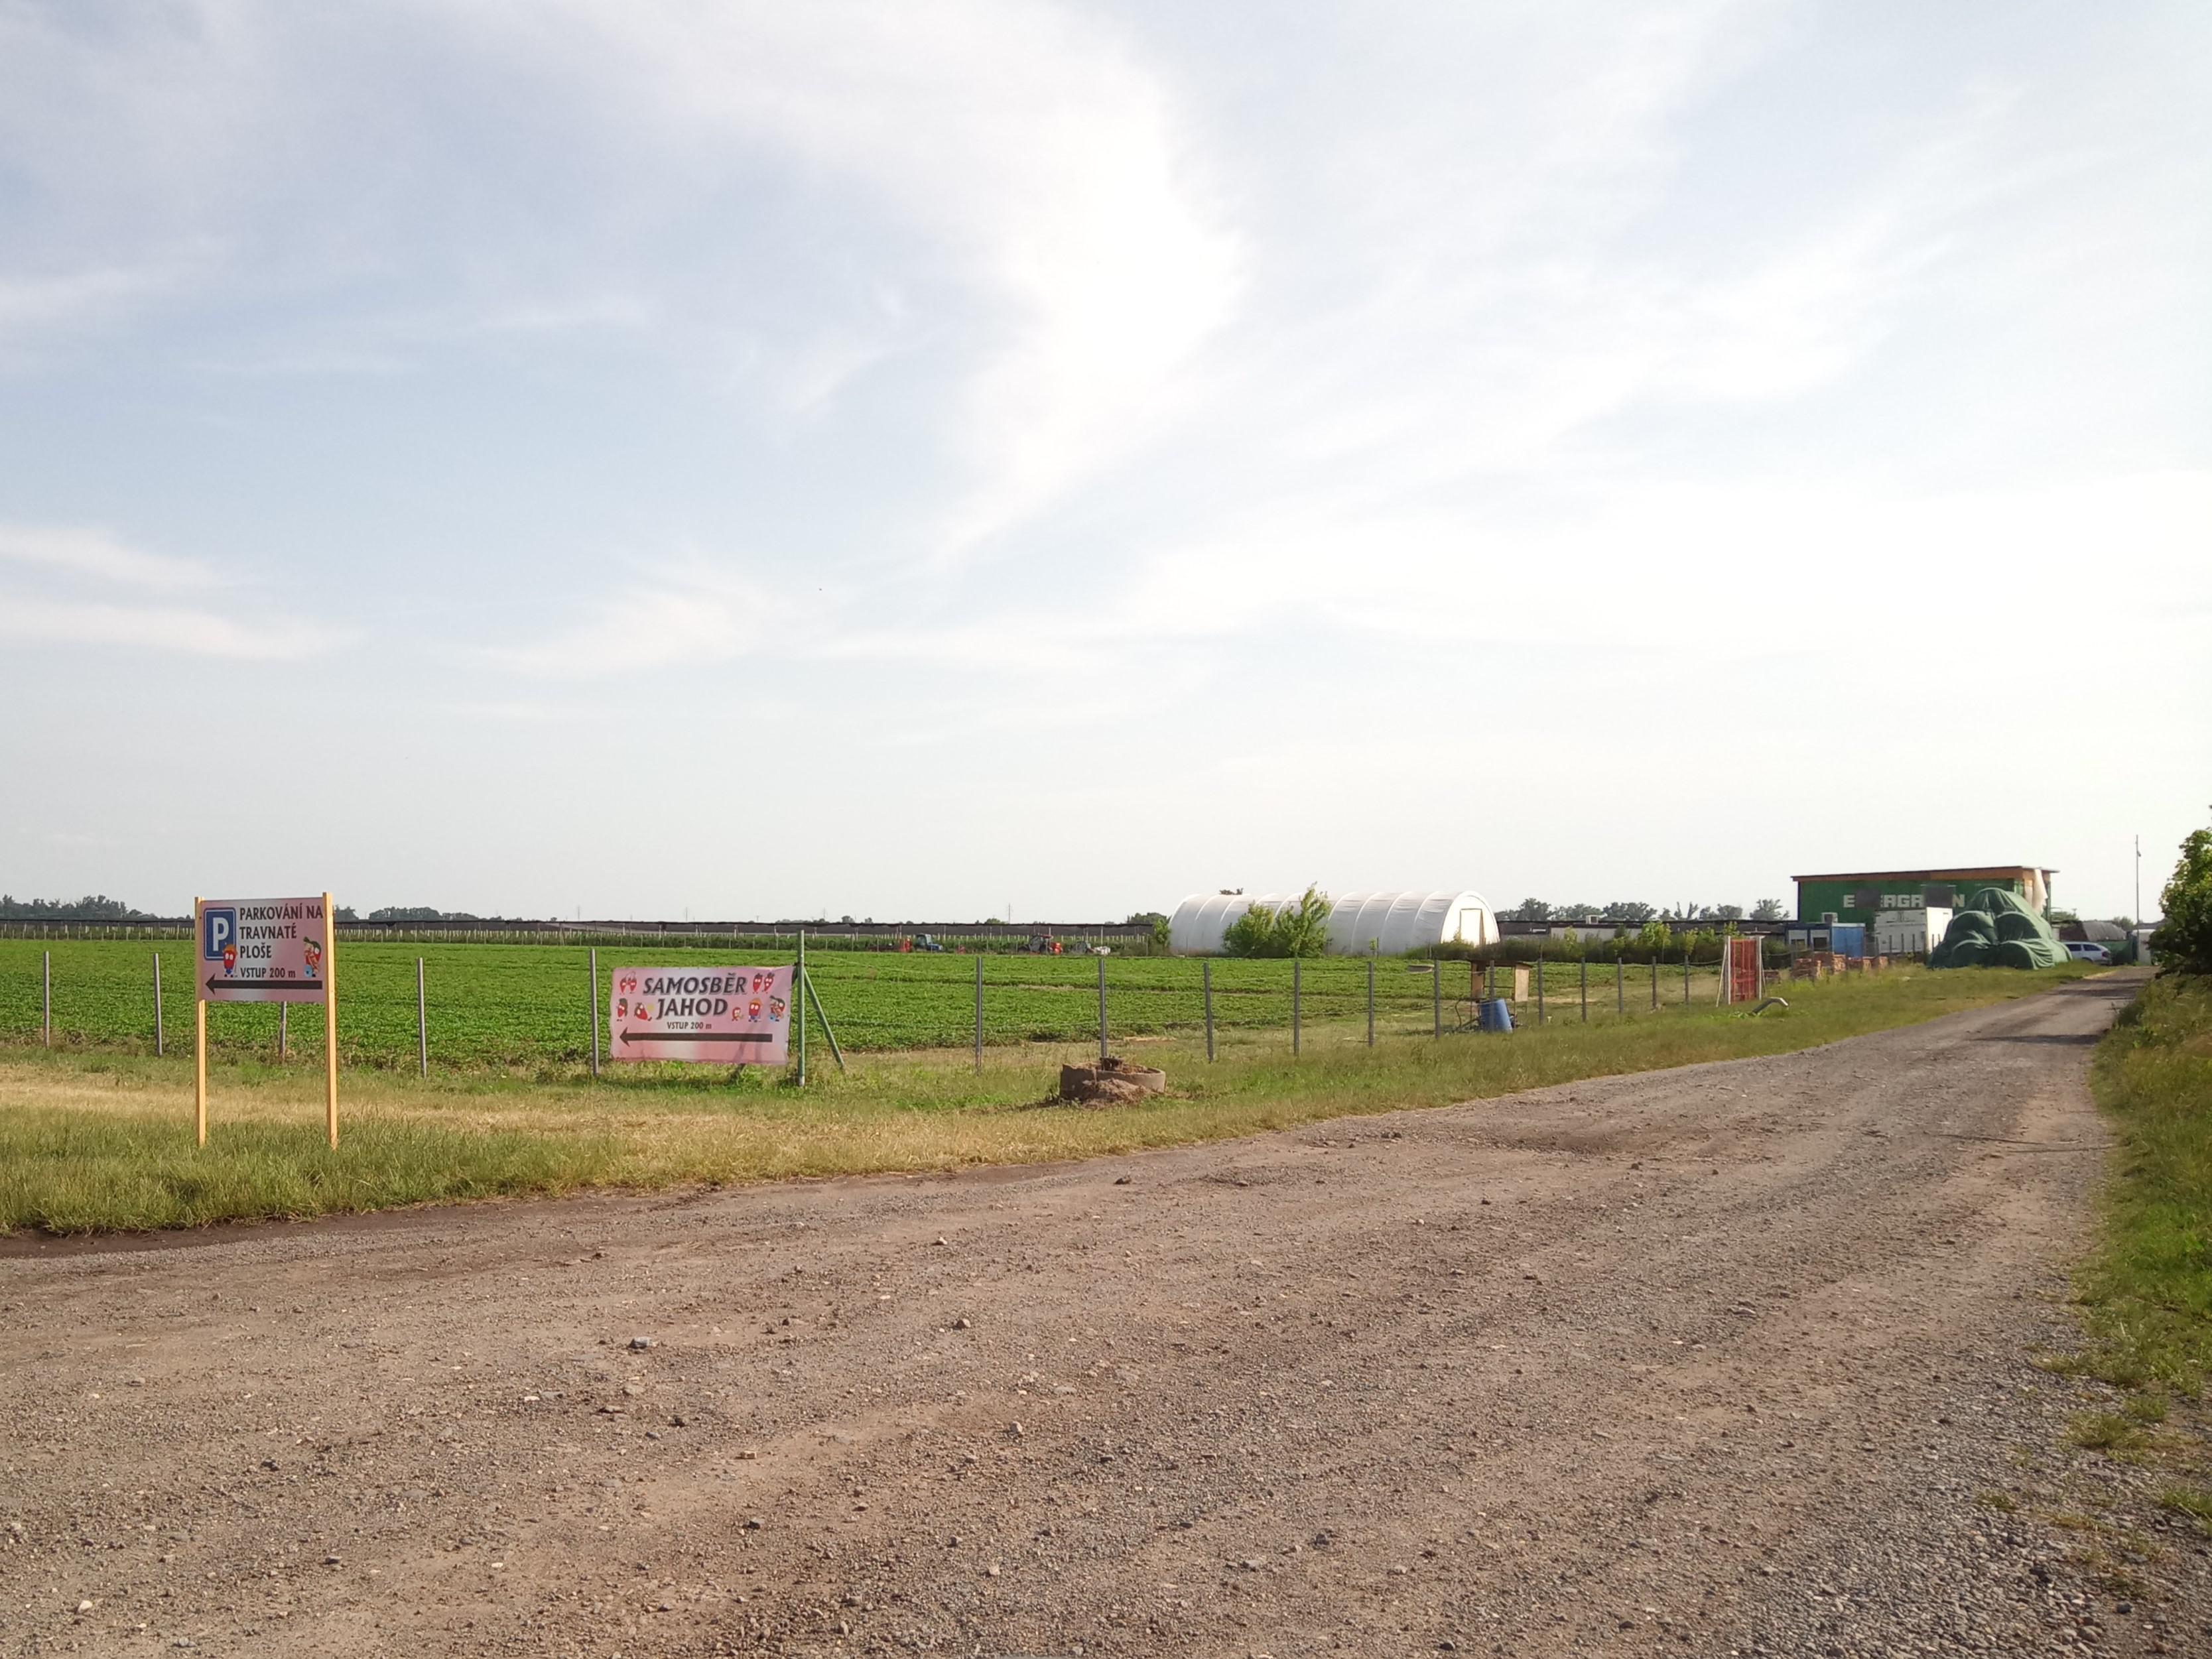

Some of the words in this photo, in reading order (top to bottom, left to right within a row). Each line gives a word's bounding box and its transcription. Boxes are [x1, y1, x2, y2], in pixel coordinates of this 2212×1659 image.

[239, 903, 302, 920] PARKOVÁNÍ
[306, 905, 324, 919] NA
[212, 917, 229, 952] P
[239, 922, 297, 940] TRAVNATÉ
[239, 942, 272, 959] PLOŠE
[240, 967, 267, 978] VSTUP
[269, 967, 286, 978] 200
[643, 972, 748, 995] SAMOSBĚR
[655, 998, 728, 1020] JAHOD
